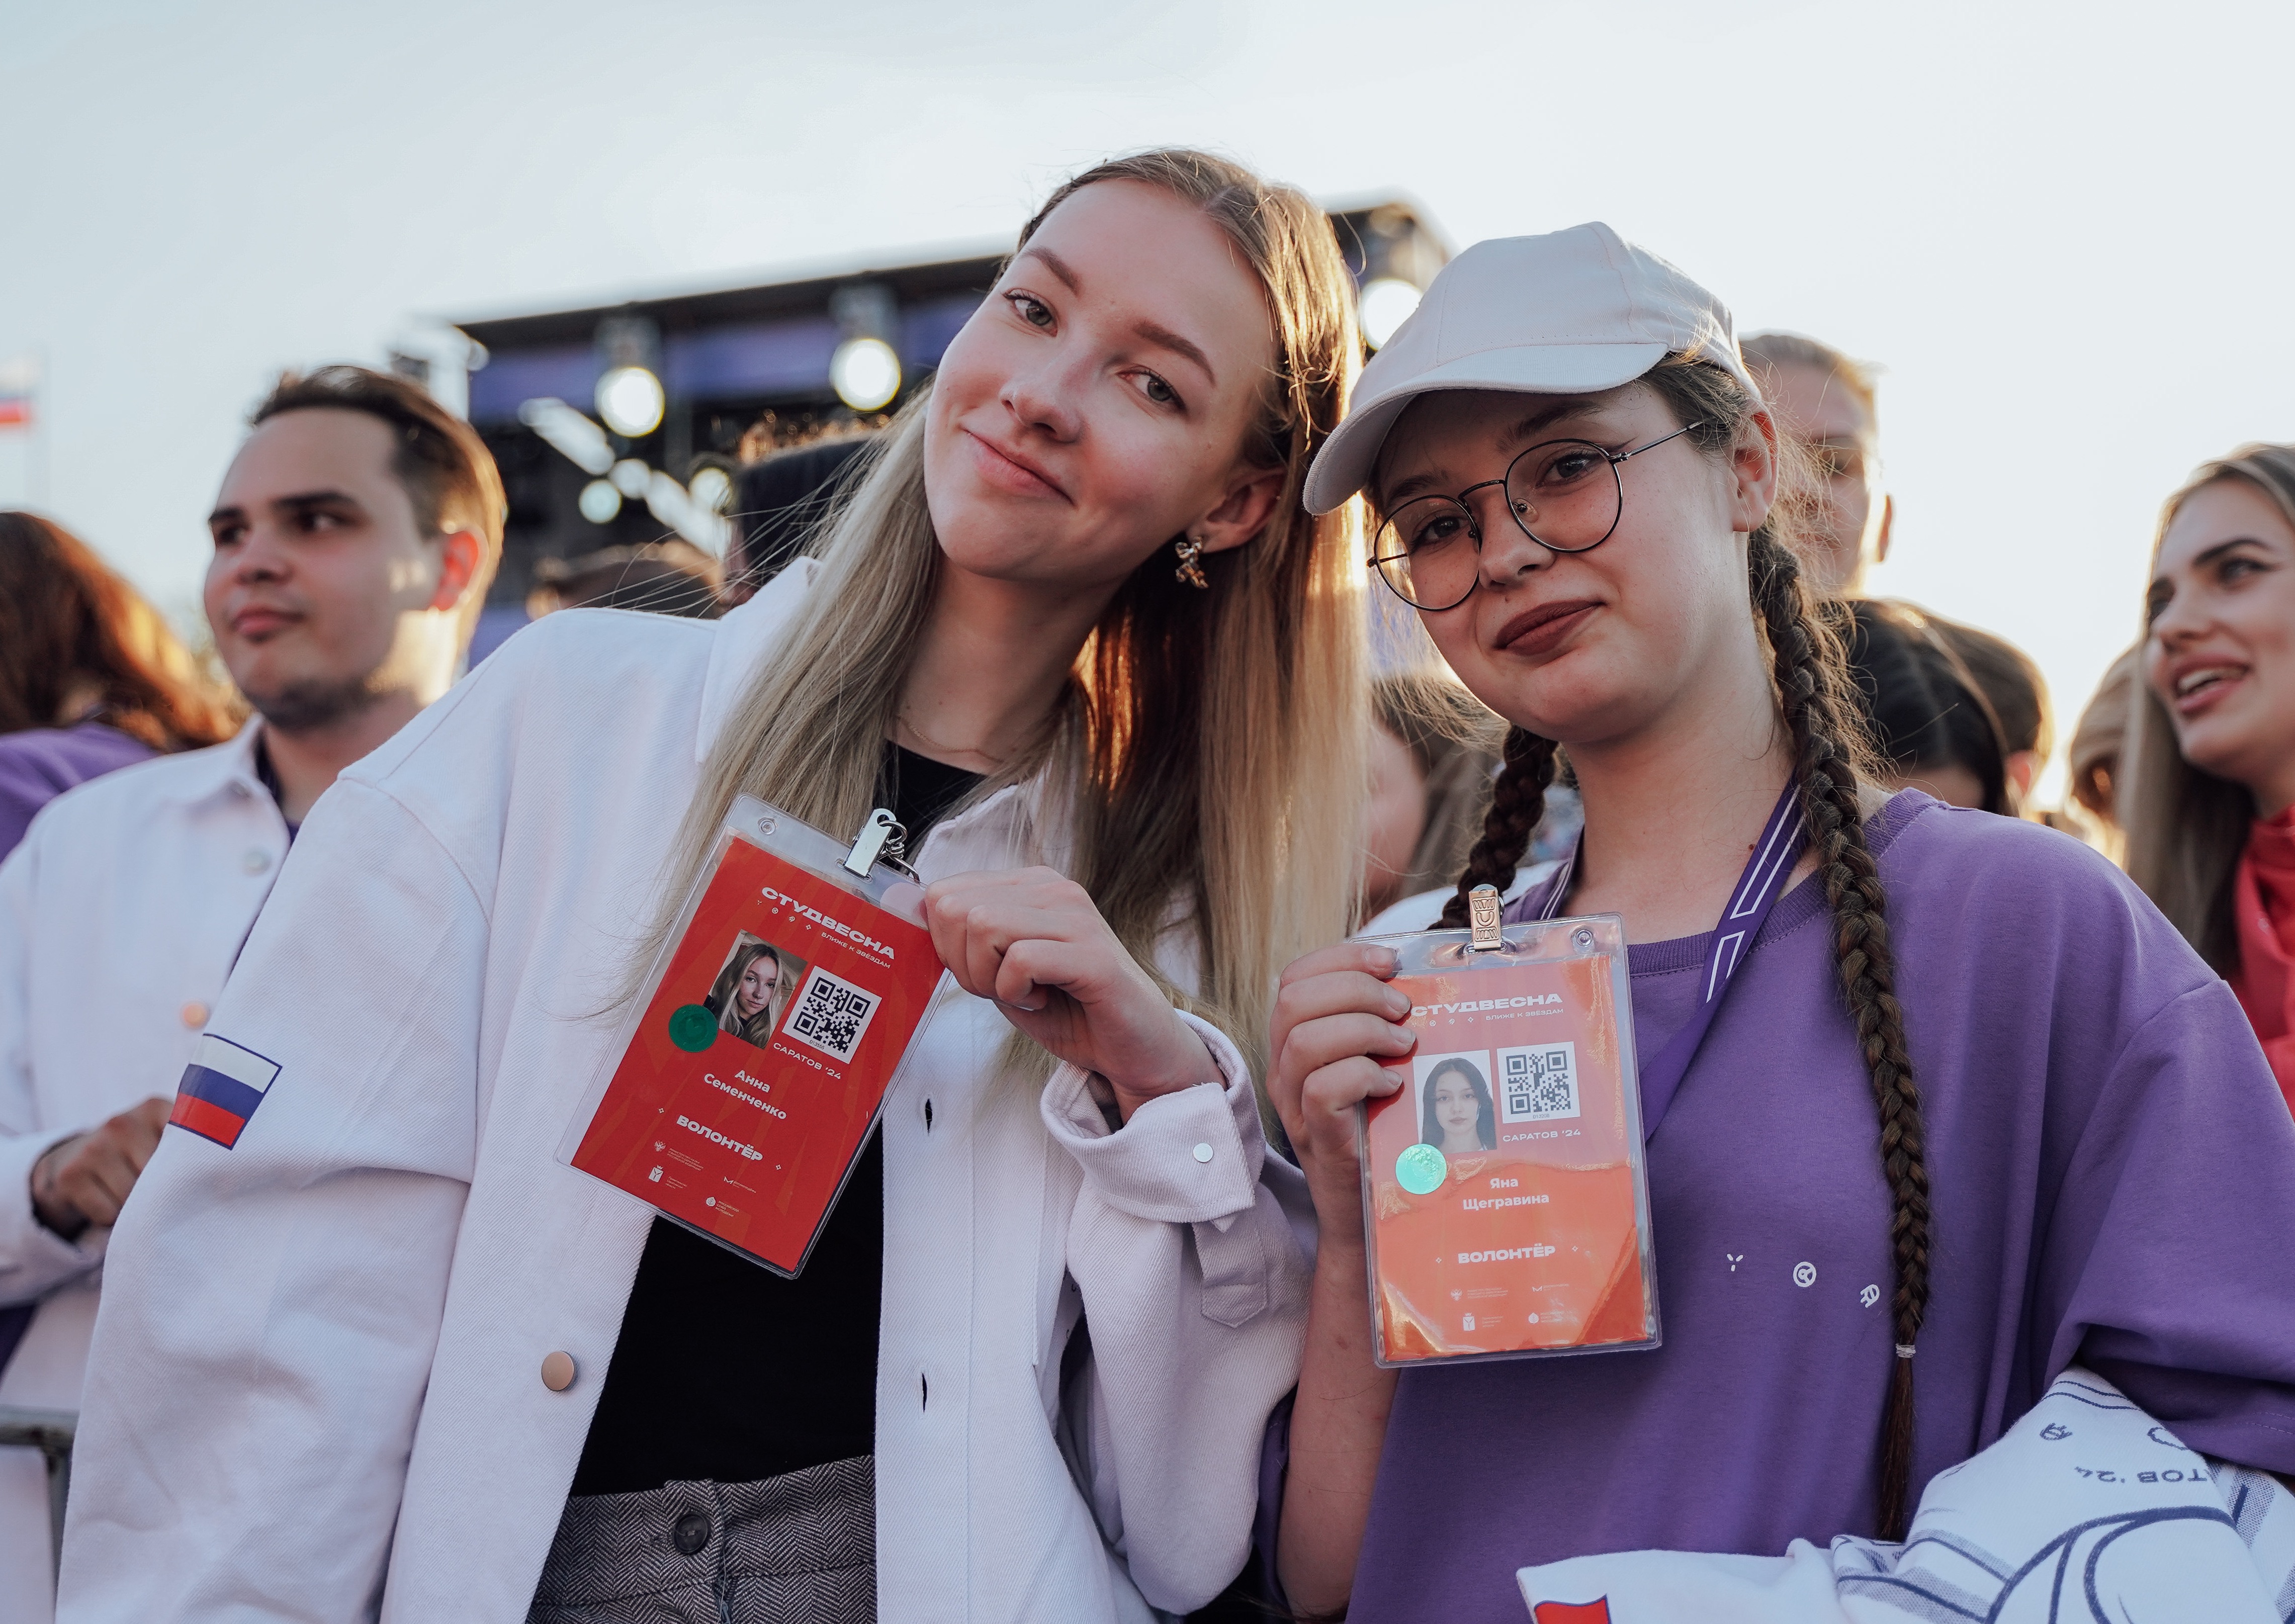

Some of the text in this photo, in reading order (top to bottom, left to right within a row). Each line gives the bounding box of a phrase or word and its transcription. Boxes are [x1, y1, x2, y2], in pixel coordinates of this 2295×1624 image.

[761, 886, 895, 960] СТУДВЕСНА
[821, 932, 848, 949] БЛИЖЕ
[856, 948, 892, 970] ЗВЁЗДАМ
[1410, 993, 1563, 1017] СТУДВЕСНА
[1485, 1013, 1515, 1021] БЛИЖЕ
[1525, 1008, 1564, 1017] ЗВЁЗДАМ
[773, 1042, 823, 1070] САРАТОВ
[734, 1069, 771, 1093] Анна
[703, 1073, 787, 1120] Семенченко
[676, 1114, 764, 1161] ВОЛОНТЁР
[1502, 1131, 1558, 1142] САРАТОВ
[1489, 1178, 1519, 1189] Яна
[1462, 1194, 1550, 1211] Щегравина
[1458, 1242, 1556, 1265] ВОЛОНТЁР
